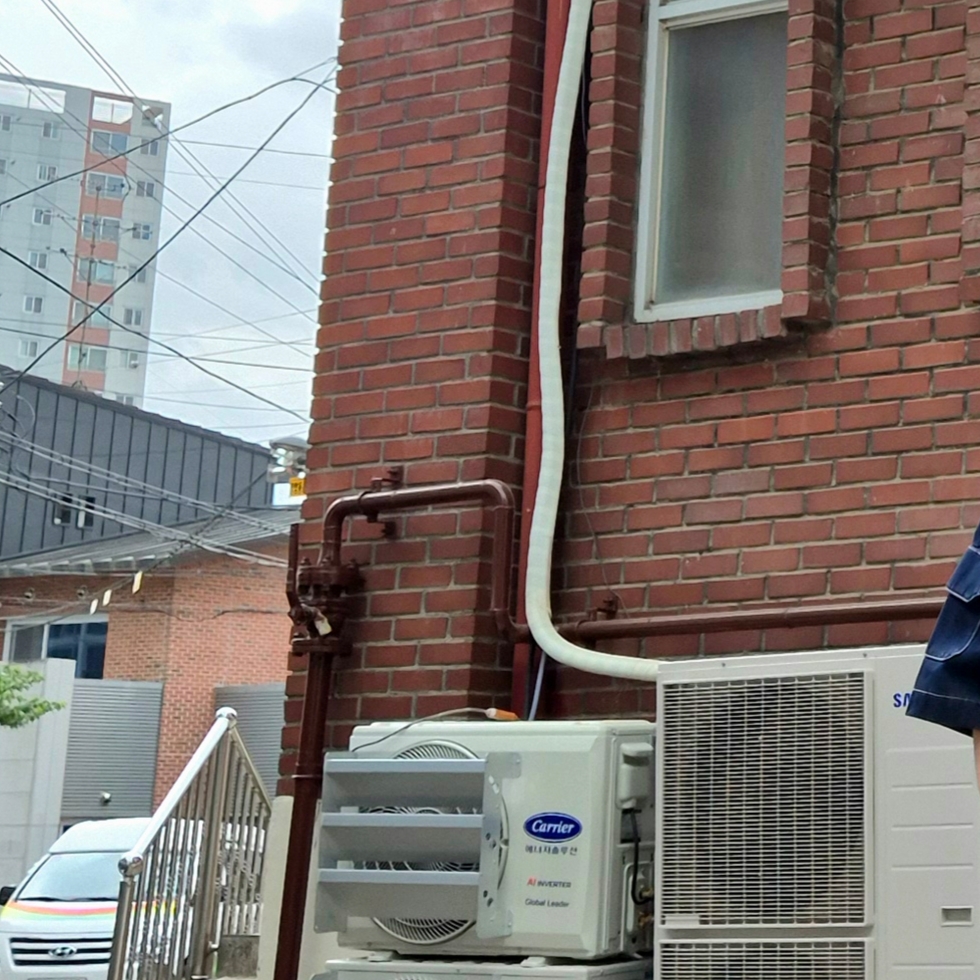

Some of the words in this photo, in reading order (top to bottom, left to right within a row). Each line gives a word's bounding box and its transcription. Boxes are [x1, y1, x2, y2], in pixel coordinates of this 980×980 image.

[531, 819, 575, 834] Carrier
[526, 877, 537, 887] AI
[537, 880, 572, 889] INVERTER
[525, 898, 546, 907] Global
